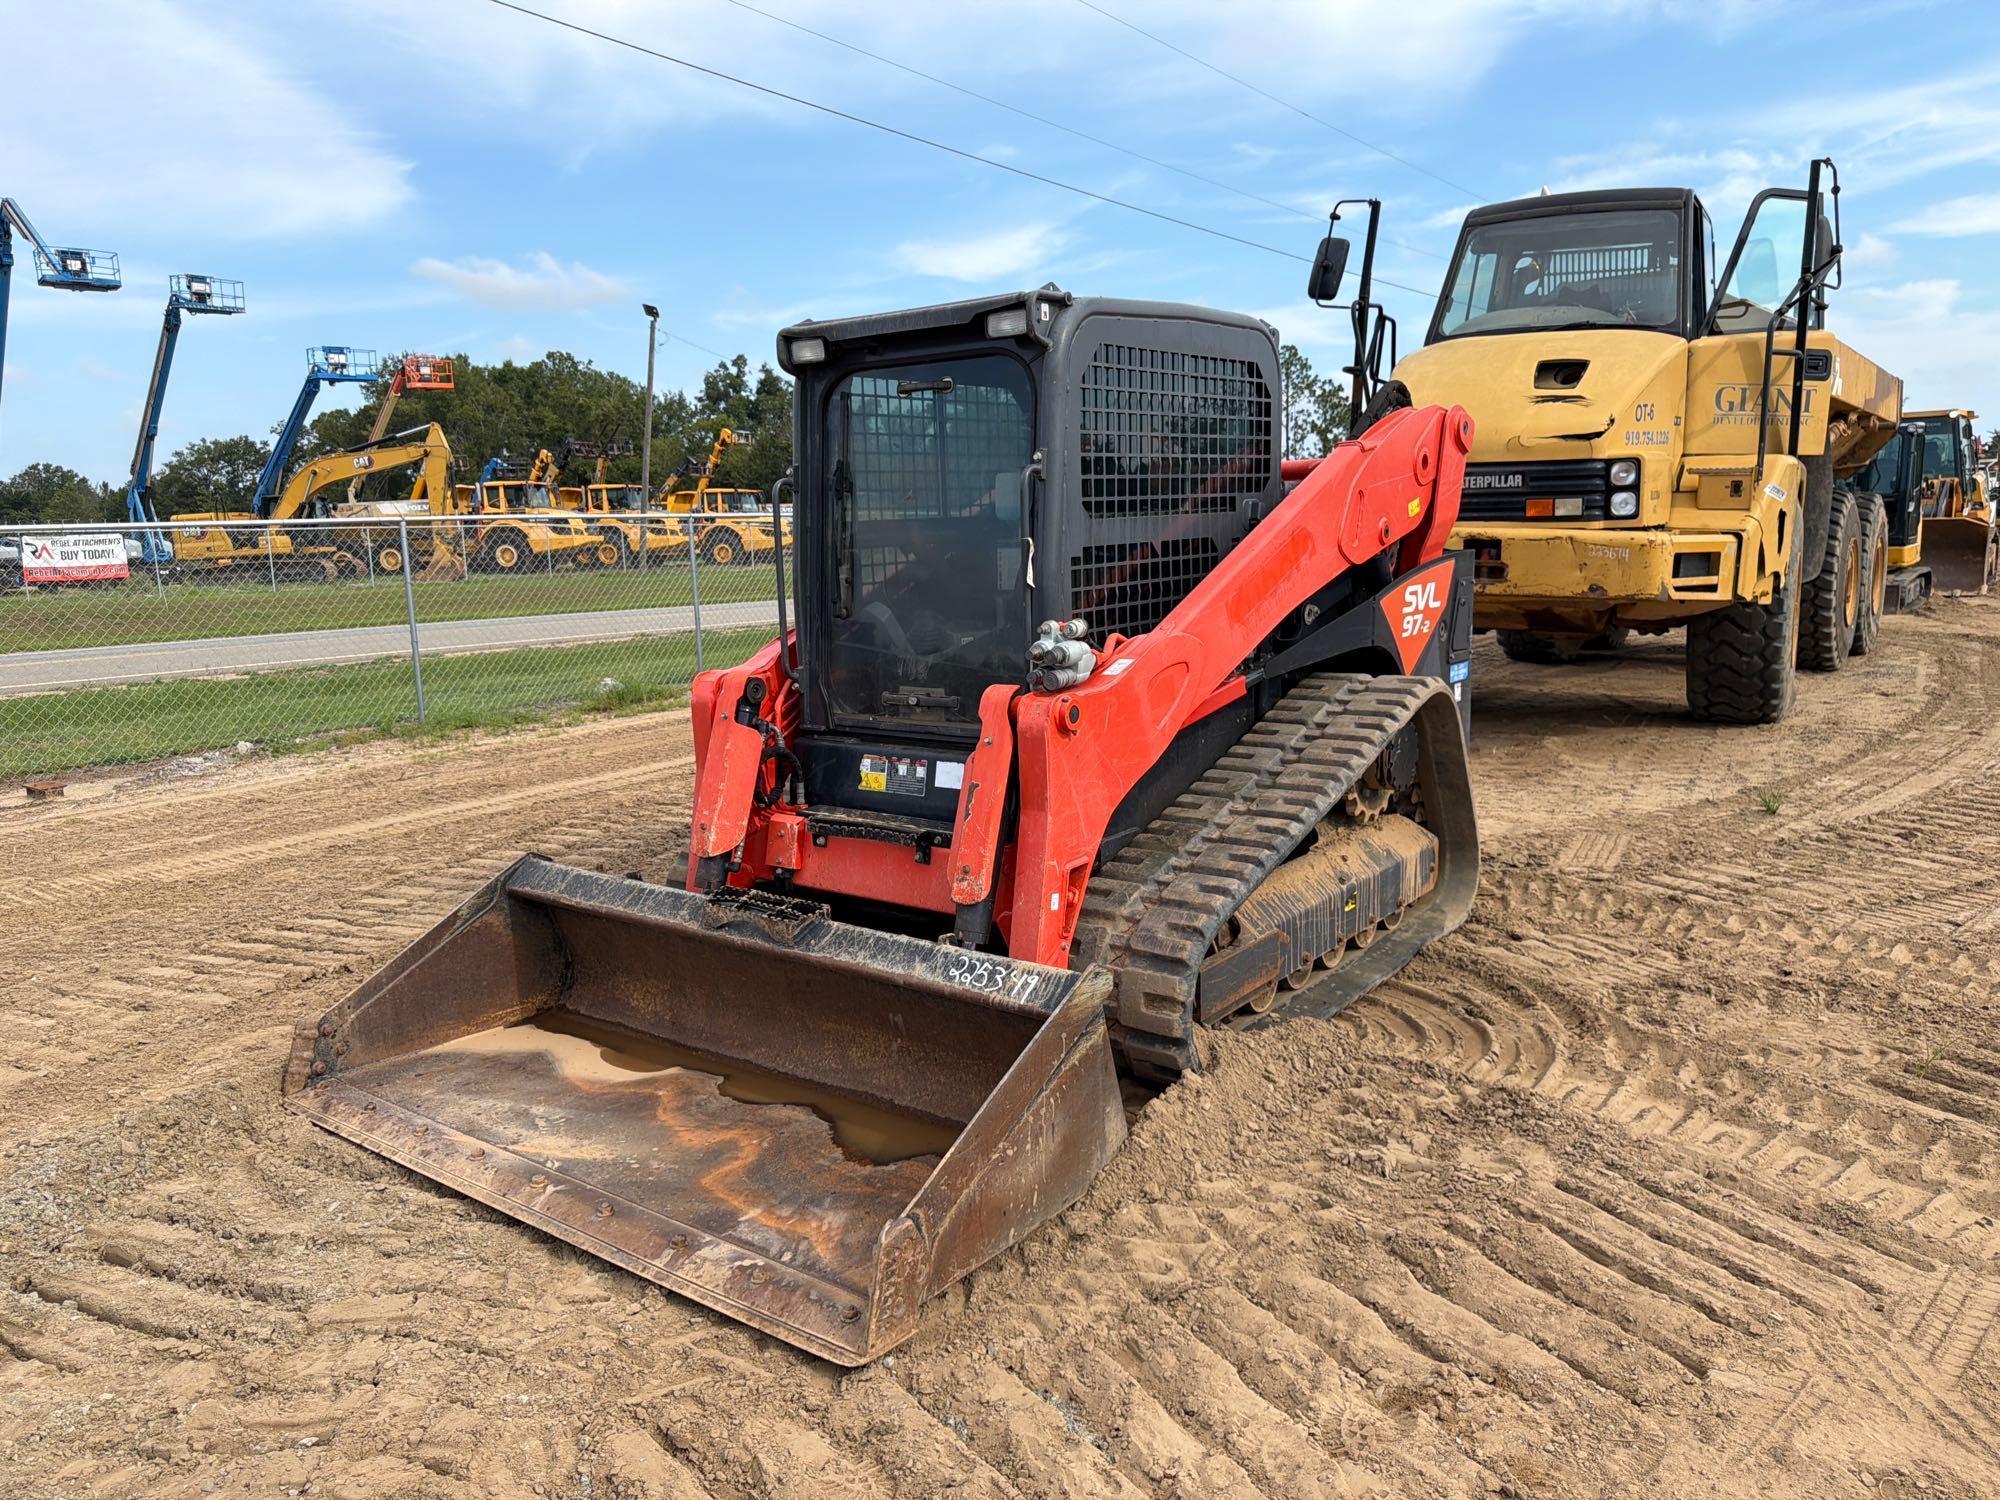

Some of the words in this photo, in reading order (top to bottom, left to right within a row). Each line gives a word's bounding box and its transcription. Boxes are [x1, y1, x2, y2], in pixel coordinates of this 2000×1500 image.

[1635, 403, 1655, 422] OT-6
[353, 456, 369, 469] CAT
[1462, 474, 1523, 489] TERPILLAR
[72, 538, 121, 547] ATTACHMENTS
[60, 550, 82, 561] BUY
[82, 548, 115, 560] TODAY!
[1402, 582, 1441, 614] SVL
[1401, 614, 1431, 638] 97-2
[950, 956, 1040, 1004] 225349
